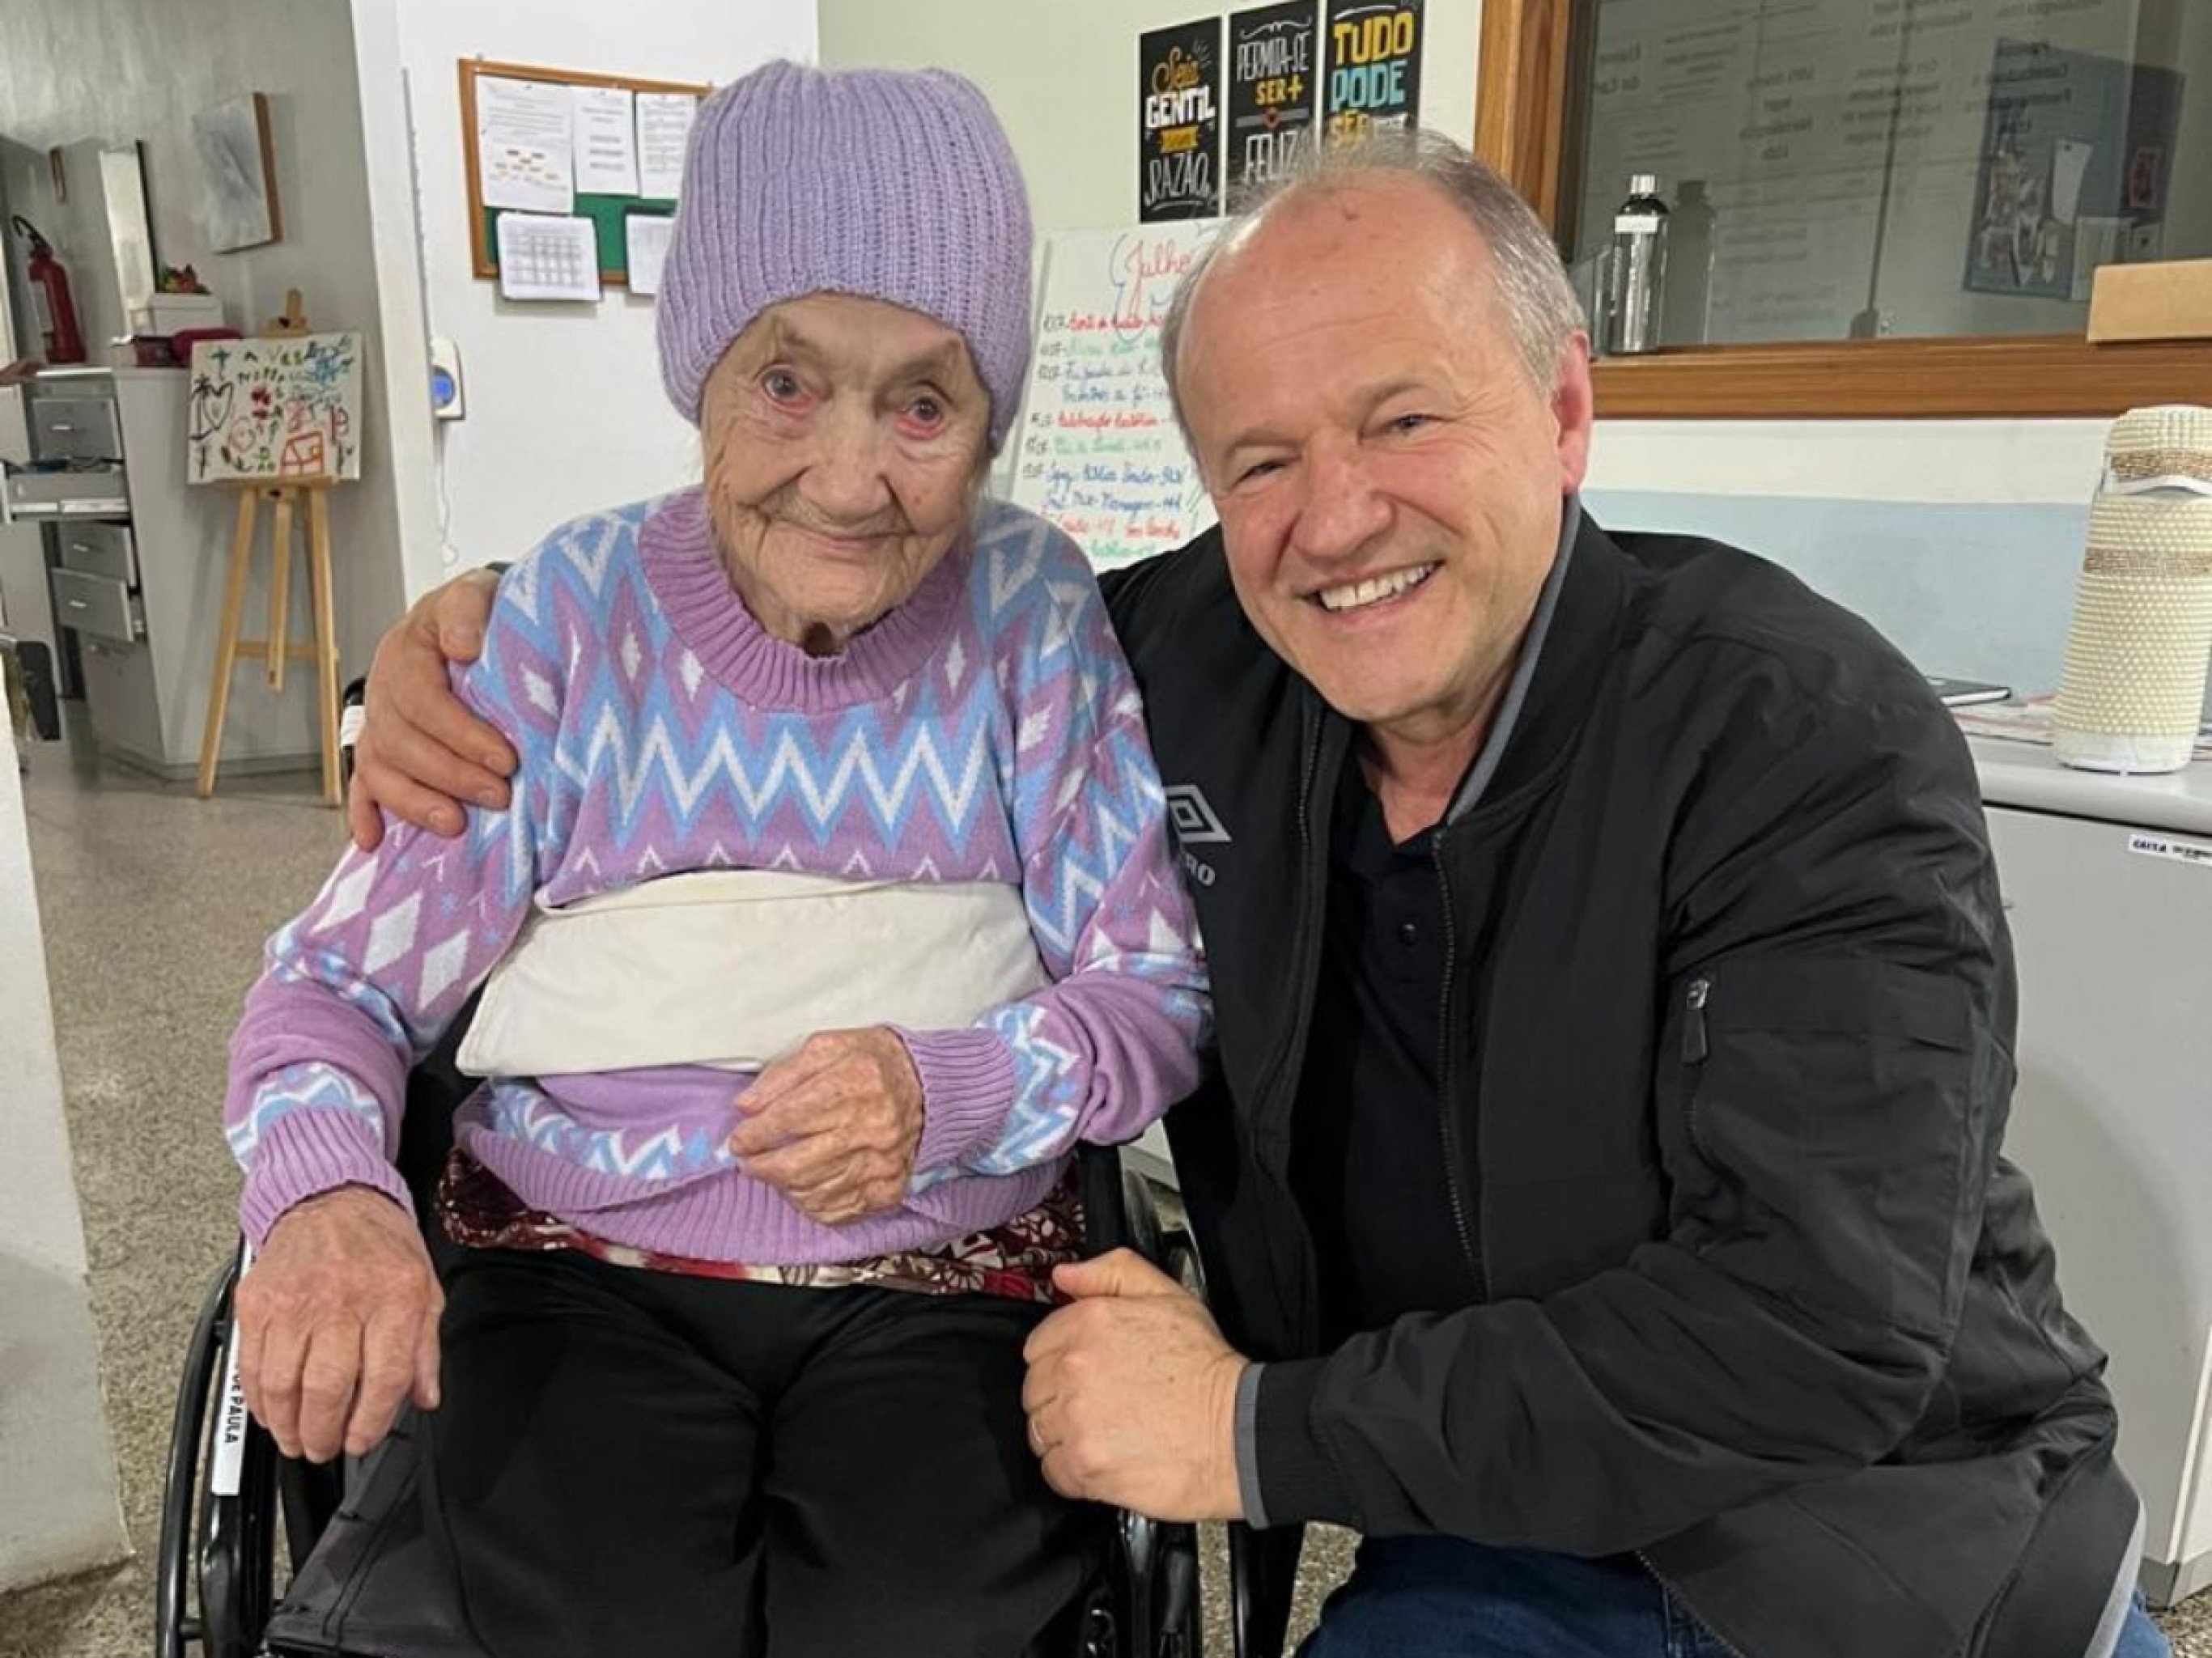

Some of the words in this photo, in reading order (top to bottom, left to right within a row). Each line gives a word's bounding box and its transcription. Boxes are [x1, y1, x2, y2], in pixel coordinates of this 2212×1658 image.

[1334, 11, 1414, 65] TUDO
[1145, 85, 1216, 129] GENTIL
[1330, 60, 1408, 112] PODE
[225, 1396, 244, 1444] PAULA
